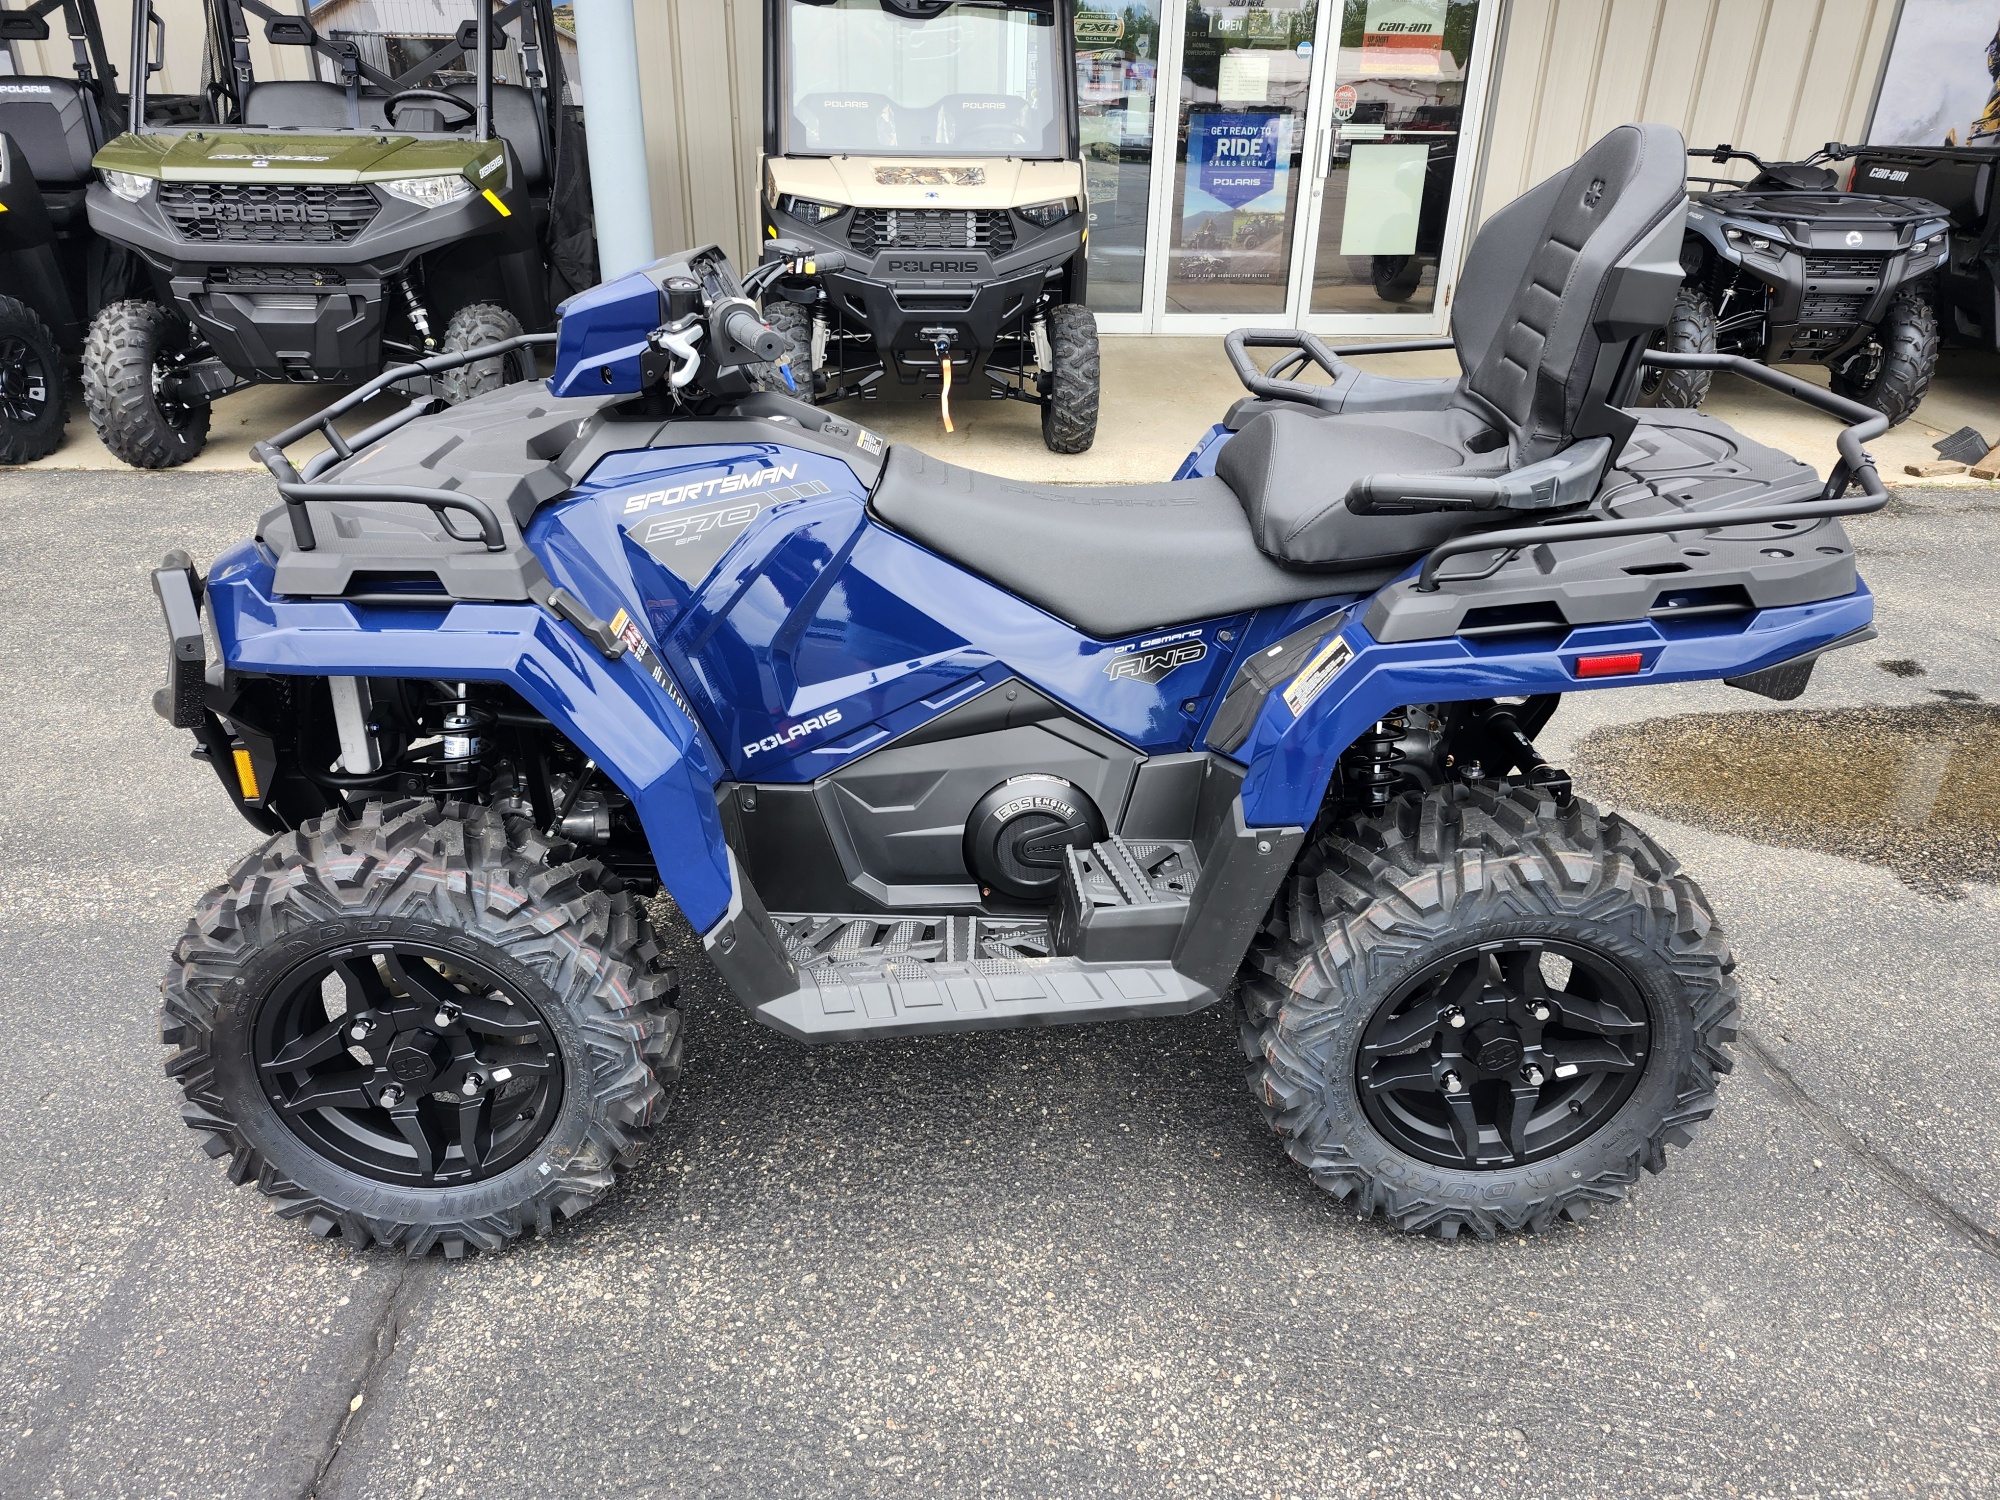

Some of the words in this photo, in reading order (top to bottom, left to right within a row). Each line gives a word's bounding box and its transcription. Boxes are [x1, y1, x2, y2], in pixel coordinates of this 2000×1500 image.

[1217, 20, 1243, 31] OPEN
[1377, 22, 1432, 33] can-am
[0, 85, 51, 94] POLARIS
[1334, 107, 1353, 117] PULL
[1211, 127, 1228, 136] GET
[1230, 127, 1258, 135] READY
[1260, 126, 1271, 135] TO
[1216, 138, 1264, 157] RIDE
[478, 154, 504, 179] 1000
[1868, 167, 1910, 182] can-am
[1213, 178, 1261, 186] POLARIS
[194, 203, 330, 223] POLARIS
[888, 260, 979, 273] POLARIS
[623, 463, 798, 515] SPORTSMAN
[644, 503, 761, 544] 570
[675, 535, 702, 546] EFI
[1114, 645, 1136, 653] ON
[1140, 629, 1203, 649] DEMAND
[1108, 643, 1208, 682] AWD
[742, 708, 843, 759] POLARIS
[998, 798, 1031, 819] EBS
[1034, 796, 1077, 816] ENGINE
